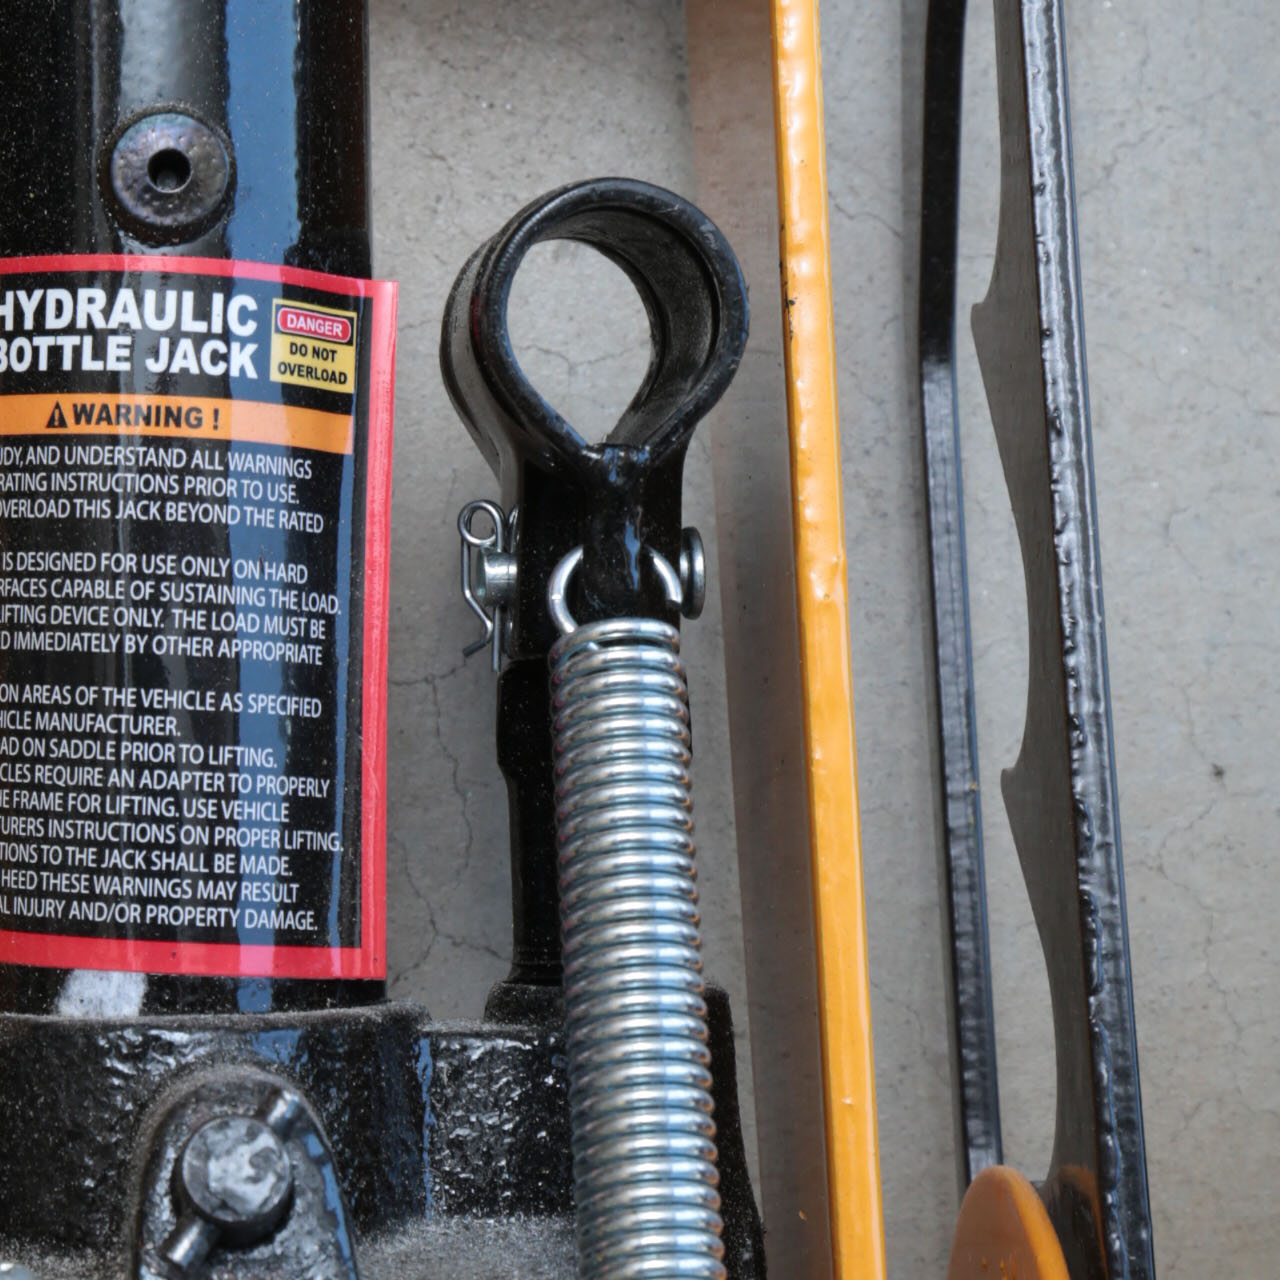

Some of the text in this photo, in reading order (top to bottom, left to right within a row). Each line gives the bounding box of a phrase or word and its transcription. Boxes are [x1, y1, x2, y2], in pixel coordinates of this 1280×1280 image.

[286, 314, 342, 337] DANGER
[145, 337, 258, 379] JACK
[290, 342, 337, 362] DO NOT
[278, 362, 348, 385] OVERLOAD
[72, 403, 203, 429] WARNING
[24, 446, 60, 466] AND
[64, 446, 187, 469] UNDERSTAND
[190, 449, 224, 471] ALL
[227, 451, 312, 479] WARNINGS
[50, 473, 180, 496] INSTRUCTIONS
[184, 477, 237, 499] PRIOR
[240, 480, 263, 501] TO
[267, 482, 299, 504] USE.
[72, 499, 111, 519] THIS
[114, 500, 162, 521] JACK
[165, 501, 240, 526] BEYOND
[243, 506, 275, 529] THE
[278, 510, 324, 534] RATED
[2, 551, 13, 571] IS
[16, 551, 96, 573] DESIGNED
[101, 553, 137, 574] FOR
[141, 554, 177, 575] USE
[180, 556, 230, 578] ONLY
[233, 559, 260, 580] ON
[263, 561, 308, 583] HARD
[50, 579, 125, 601] CAPABLE
[130, 582, 155, 602] OF
[160, 583, 265, 609] SUSTAINING
[269, 590, 298, 611] THE
[301, 592, 341, 615] LOAD.
[52, 605, 108, 627] DEVICE
[113, 607, 164, 629] ONLY.
[173, 610, 206, 631] THE
[211, 612, 260, 635] LOAD
[263, 615, 308, 638] MUST
[310, 619, 325, 640] BE
[13, 632, 121, 654] IMMEDIATELY
[124, 635, 147, 655] BY
[151, 636, 213, 658] OTHER
[217, 639, 322, 665] APPROPRIATE
[21, 684, 71, 705] AREAS
[74, 686, 98, 706] OF
[101, 687, 136, 708] THE
[139, 689, 215, 712] VEHICLE
[219, 692, 243, 713] AS
[246, 694, 322, 718] SPECIFIED
[35, 711, 181, 737] MANUFACTURER.
[22, 736, 45, 757] ON
[48, 738, 116, 761] SADDLE
[120, 741, 175, 764] PRIOR
[178, 744, 204, 765] TO
[208, 746, 277, 768] LIFTING.
[34, 765, 103, 788] REQUIRE
[106, 769, 135, 789] AN
[138, 770, 225, 793] ADAPTER
[228, 774, 252, 794] TO
[256, 775, 330, 797] PROPERLY
[12, 790, 63, 812] FRAME
[67, 793, 101, 814] FOR
[106, 795, 179, 818] LIFTING.
[182, 799, 217, 820] USE
[221, 800, 289, 822] VEHICLE
[48, 819, 175, 842] INSTRUCTIONS
[179, 825, 209, 846] ON
[214, 827, 281, 849] PROPER
[284, 830, 344, 852] LIFTING.
[40, 844, 62, 865] TO
[64, 846, 97, 867] THE
[100, 848, 147, 870] JACK
[150, 851, 209, 874] SHALL
[213, 854, 235, 875] BE
[239, 855, 292, 877] MADE.
[1, 867, 37, 889] HEED
[39, 870, 90, 893] THESE
[92, 873, 192, 898] WARNINGS
[196, 879, 237, 901] MAY
[240, 881, 299, 903] RESULT
[13, 895, 65, 919] INJURY
[68, 900, 141, 924] AND/OR
[146, 905, 240, 929] PROPERTY
[245, 910, 317, 931] DAMAGE.
